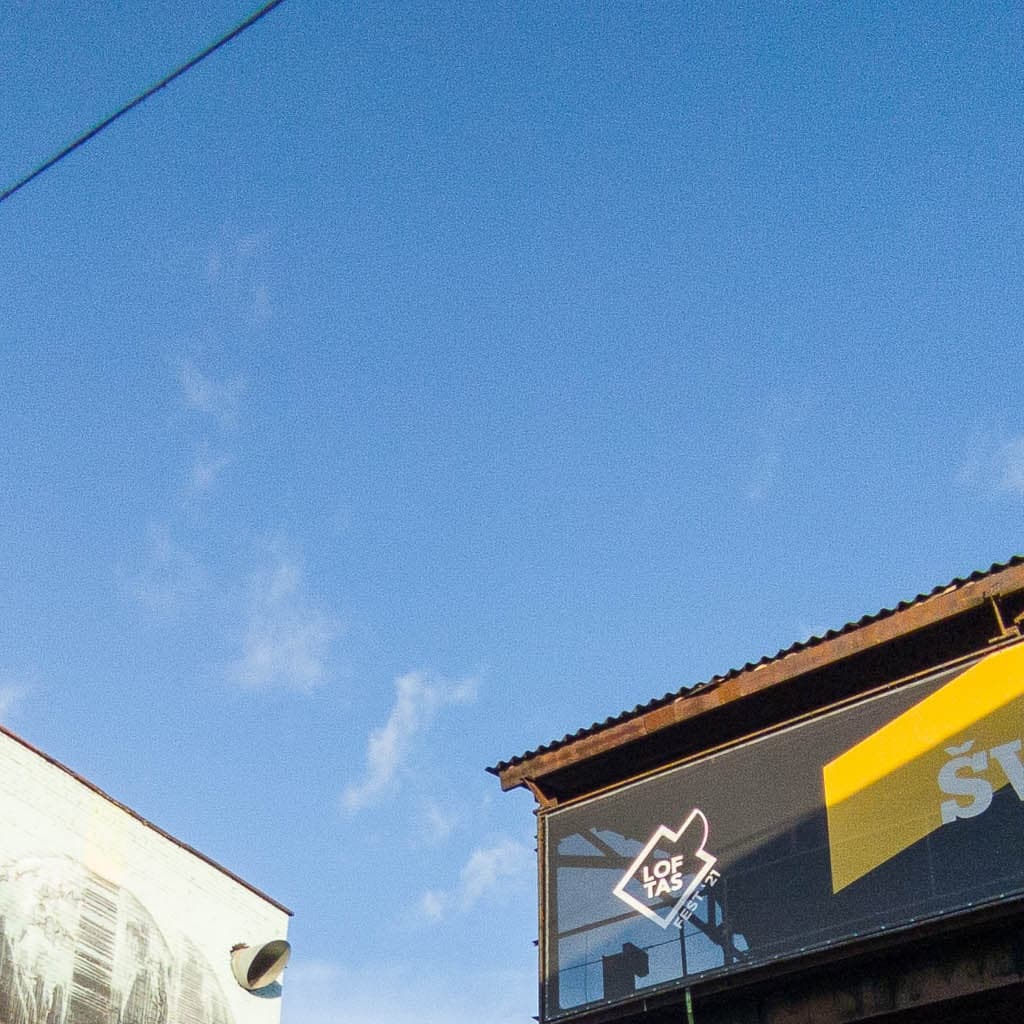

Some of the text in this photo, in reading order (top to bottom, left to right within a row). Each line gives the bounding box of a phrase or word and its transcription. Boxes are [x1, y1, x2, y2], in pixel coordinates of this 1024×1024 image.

[643, 855, 684, 883] LOF
[643, 872, 683, 899] TAS
[673, 891, 703, 929] FEST
